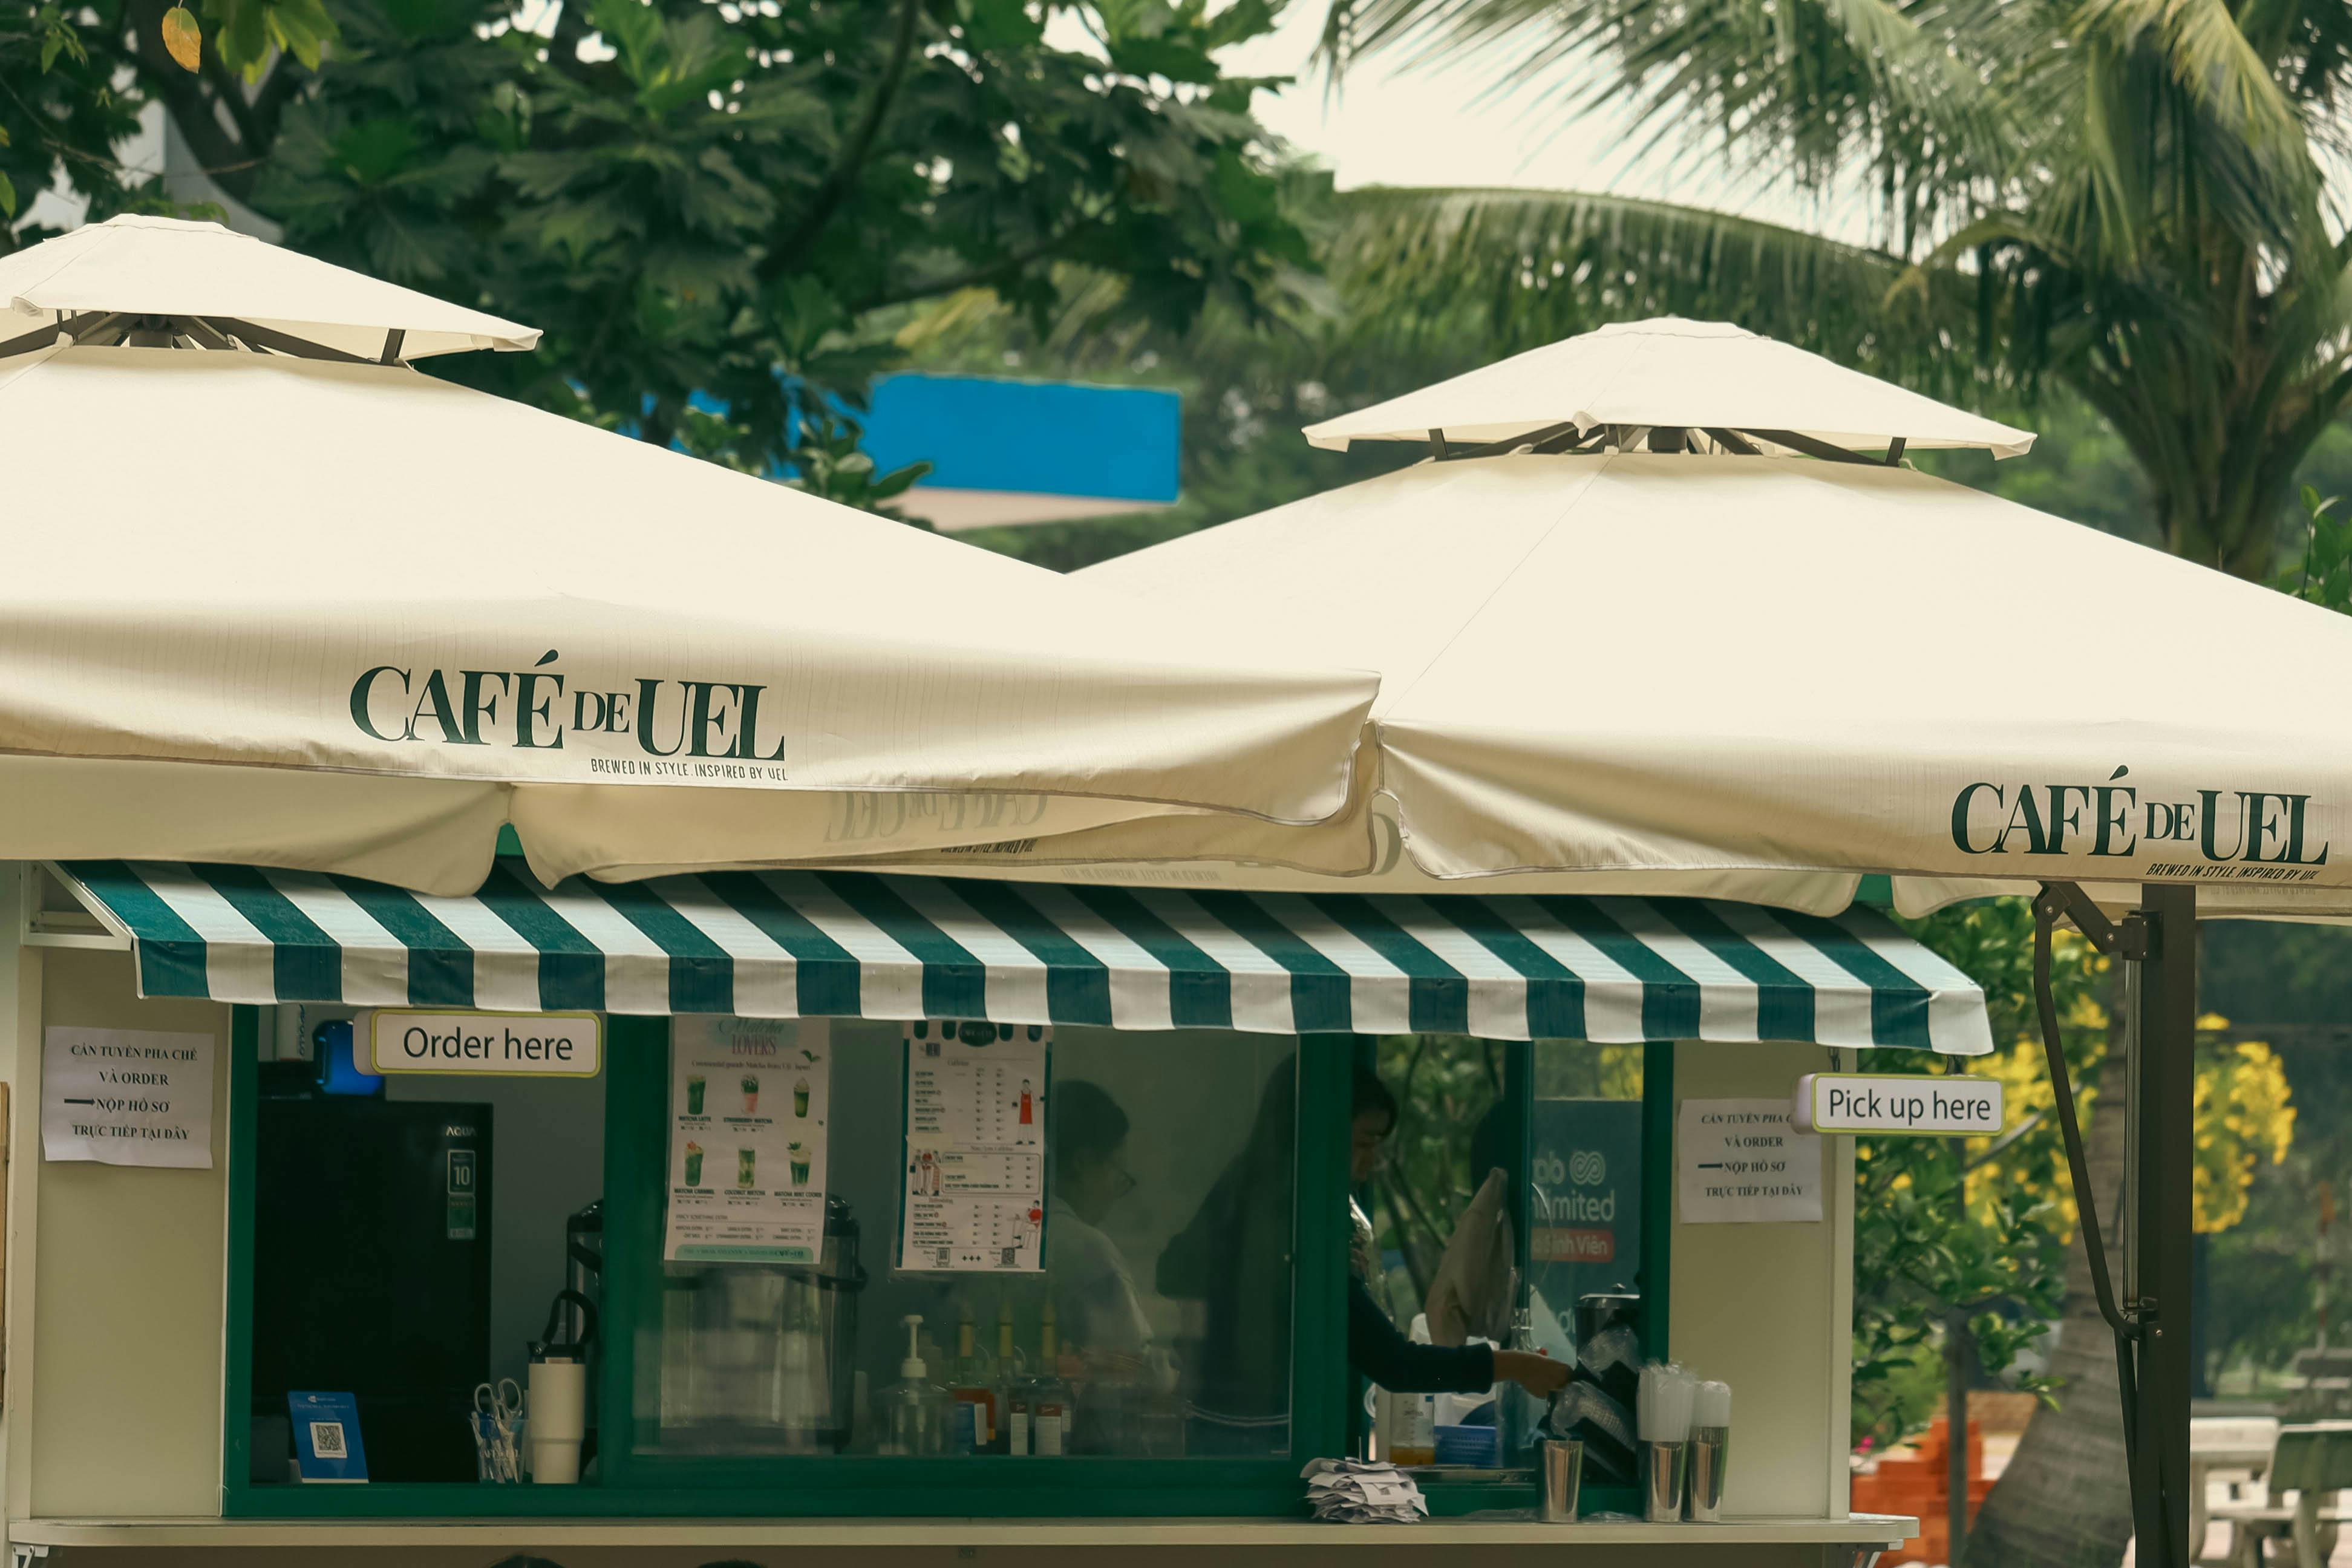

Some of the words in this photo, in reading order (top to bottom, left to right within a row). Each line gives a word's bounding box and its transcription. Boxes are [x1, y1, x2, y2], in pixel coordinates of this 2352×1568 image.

[350, 649, 564, 750] CAFÉ
[571, 691, 631, 733] DE
[635, 678, 785, 762] UEL
[591, 759, 635, 774] BREWED
[639, 762, 651, 776] IN
[695, 765, 745, 779] INSPIRED
[750, 767, 762, 780] BY
[768, 768, 788, 781] UEL
[1952, 765, 2136, 857] CAFÉ
[2144, 802, 2195, 840] DE
[2197, 789, 2328, 865] UEL
[2146, 863, 2191, 876] BREWED
[2188, 865, 2203, 877] IN
[2236, 866, 2285, 880] INSPIRED
[2282, 869, 2301, 880] BY
[403, 1026, 494, 1059] Order
[505, 1027, 573, 1060] here
[145, 1048, 169, 1060] PHA
[99, 1068, 118, 1084] VÀ
[122, 1072, 169, 1086] ORDER
[152, 1100, 171, 1113] SƠ
[1829, 1088, 1881, 1119] Pick
[1890, 1096, 1924, 1126] up
[1934, 1091, 1991, 1120] here
[1762, 1114, 1783, 1123] PHA
[142, 1127, 162, 1142] TẠI
[446, 1126, 476, 1136] AQUA
[1725, 1134, 1740, 1148] VÀ
[1743, 1136, 1784, 1148] ORDER
[1771, 1161, 1786, 1172] SƠ
[454, 1166, 470, 1186] 10
[1762, 1186, 1779, 1198] TẠI
[1532, 1189, 1615, 1222] nlimited
[1575, 1235, 1608, 1255] Viên
